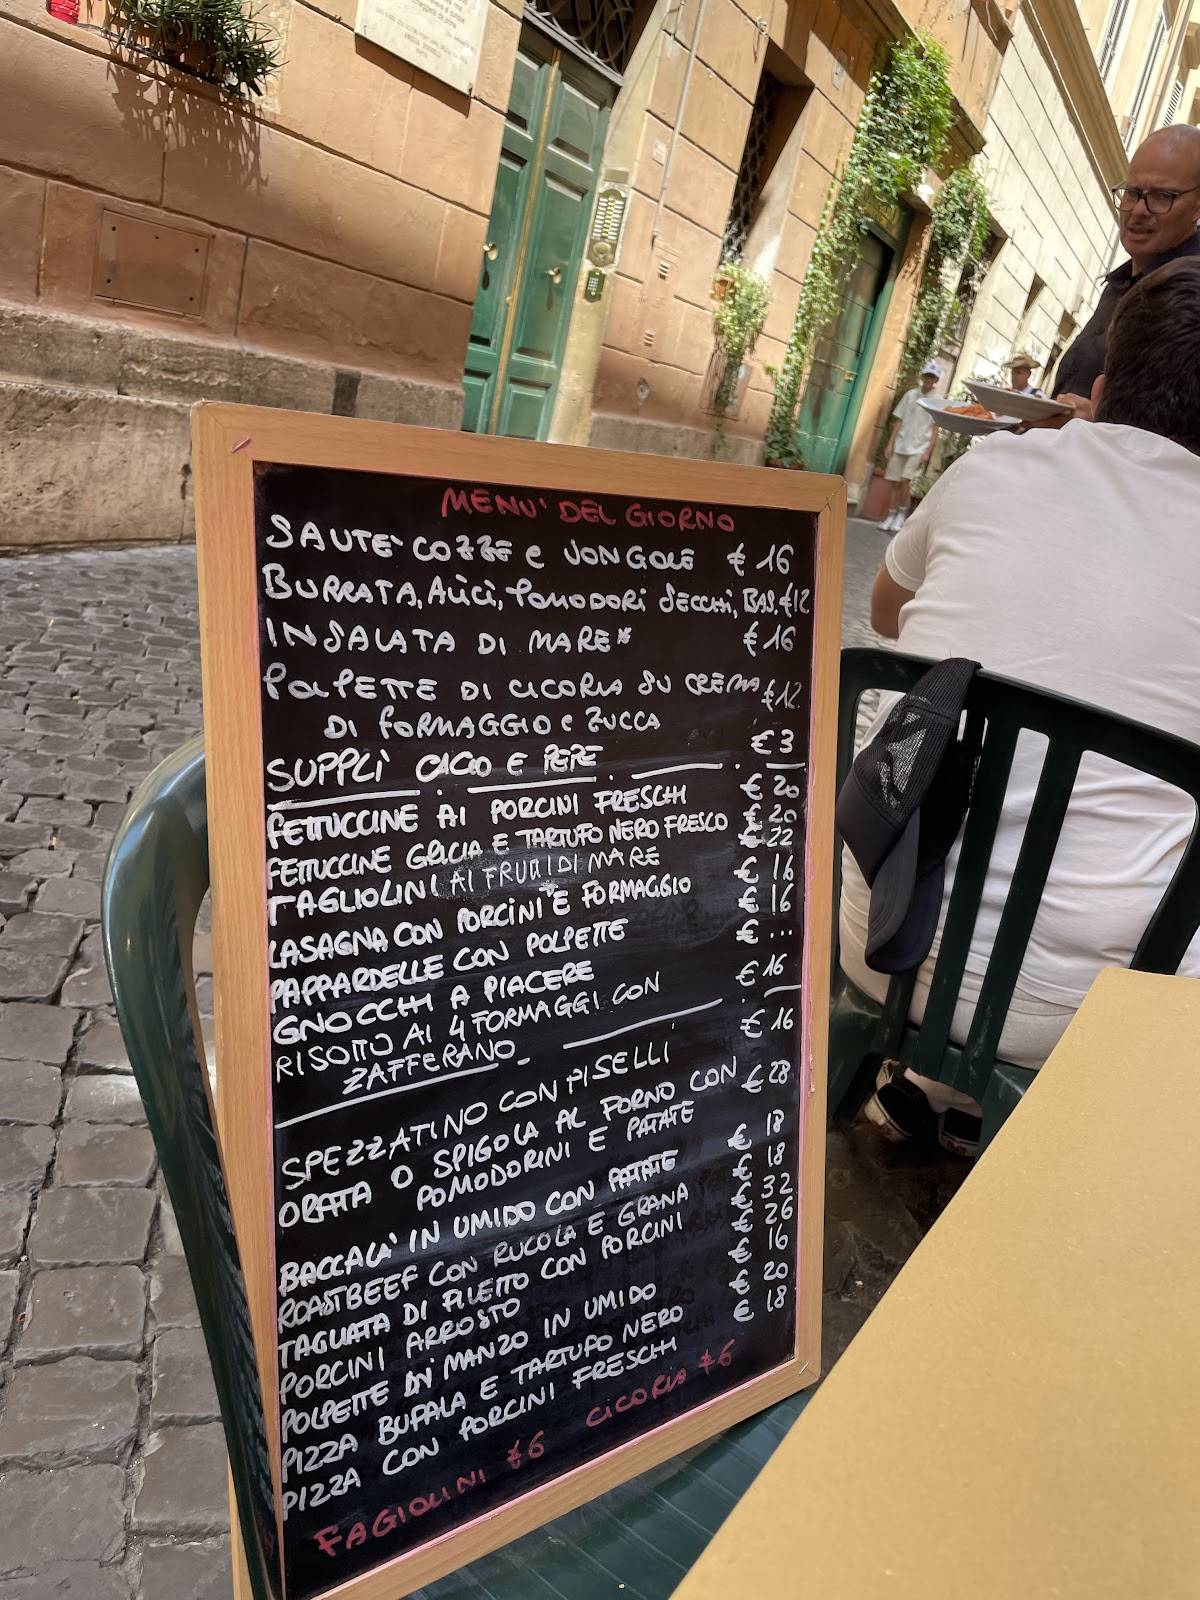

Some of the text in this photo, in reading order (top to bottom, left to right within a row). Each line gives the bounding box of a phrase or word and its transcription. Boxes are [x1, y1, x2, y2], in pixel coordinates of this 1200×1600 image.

[413, 535, 512, 562] COZZE
[563, 539, 695, 571] VONGOLE
[727, 543, 746, 576] €
[755, 543, 795, 574] 16
[559, 499, 616, 526] DEL
[625, 503, 735, 532] GIORNO
[265, 617, 456, 653] INSALATA
[478, 632, 506, 656] DI
[743, 620, 759, 657] €
[763, 624, 796, 652] 16
[461, 680, 491, 701] DI
[509, 671, 623, 701] CICORIA
[638, 670, 672, 696] SU
[685, 672, 761, 696] CREMA
[324, 714, 358, 739] DI
[585, 706, 661, 733] ZUCCA
[507, 752, 528, 776] E
[544, 743, 603, 775] PEPE
[751, 729, 775, 755] €
[779, 728, 794, 754] 3
[266, 845, 392, 890] FETTUCCINE
[406, 839, 483, 870] GRICIA
[491, 833, 510, 855] E
[515, 822, 603, 848] TARTUFO
[609, 818, 660, 844] NERO
[664, 812, 728, 839] FRESCO
[768, 803, 797, 824] 20
[436, 803, 466, 829] AI
[490, 793, 579, 824] PORCINI
[593, 784, 687, 814] FRESCHI
[739, 772, 763, 800] €
[773, 774, 800, 798] 20
[267, 873, 440, 926] TAGLIOLINI
[450, 864, 474, 895] AI
[557, 853, 578, 874] DI
[588, 846, 661, 873] MARE
[766, 825, 794, 847] 22
[269, 926, 389, 969] LASAGNA
[393, 917, 444, 947] CON
[553, 890, 571, 916] E
[582, 873, 692, 908] FORMAGGIO
[733, 855, 759, 884] €
[773, 853, 794, 881] 16
[269, 883, 794, 1014] PAPPARDELLE CON POLPETTE € 16
[273, 993, 434, 1045] GNOCCHI
[451, 984, 471, 1009] A
[484, 960, 595, 1003] PIACERE
[736, 918, 759, 944] €
[275, 953, 787, 1083] RISOTTO AI 4 FORMAGGI CON € 16
[342, 1039, 516, 1094] ZAFFERANO
[278, 1181, 373, 1227] ORATA
[391, 1164, 414, 1188] O
[433, 1121, 539, 1178] SPIGOLA
[556, 1107, 586, 1134] AL
[600, 1081, 675, 1121] FORNO
[690, 1055, 736, 1091] CON
[769, 1060, 791, 1085] 28
[282, 1007, 794, 1190] SPEZZATINO CON PISELLI € 16
[417, 1100, 694, 1211] POMODORINI E PATATE
[277, 1142, 786, 1333] ROASTBEEF CON RUCOLA E GRANA € 18
[409, 1220, 440, 1253] IN
[453, 1201, 536, 1239] UMIDO
[545, 1180, 595, 1215] CON
[608, 1149, 679, 1192] PATATE
[727, 1123, 752, 1151] €
[766, 1109, 785, 1136] 18
[280, 1195, 794, 1405] PORCINI ARROSTO € 26
[403, 1300, 428, 1326] DI
[442, 1273, 529, 1312] FILETTO
[540, 1247, 586, 1280] CON
[601, 1211, 683, 1260] PORCINI
[731, 1181, 753, 1209] €
[761, 1172, 793, 1199] 32
[281, 1380, 389, 1443] POLPETTE
[444, 1331, 529, 1380] MANZO
[544, 1307, 571, 1338] IN
[585, 1282, 656, 1320] UMIDO
[728, 1237, 752, 1264] €
[768, 1223, 788, 1250] 16
[281, 1260, 788, 1483] PIZZA BUFALA E TARTUFO NERO € 20
[282, 1467, 362, 1521] PIZZA
[382, 1437, 439, 1475] CON
[458, 1382, 555, 1441] PORCINI
[572, 1336, 678, 1389] FRESCHI
[766, 1285, 787, 1312] 18
[312, 1468, 487, 1557] FAGIOLINI
